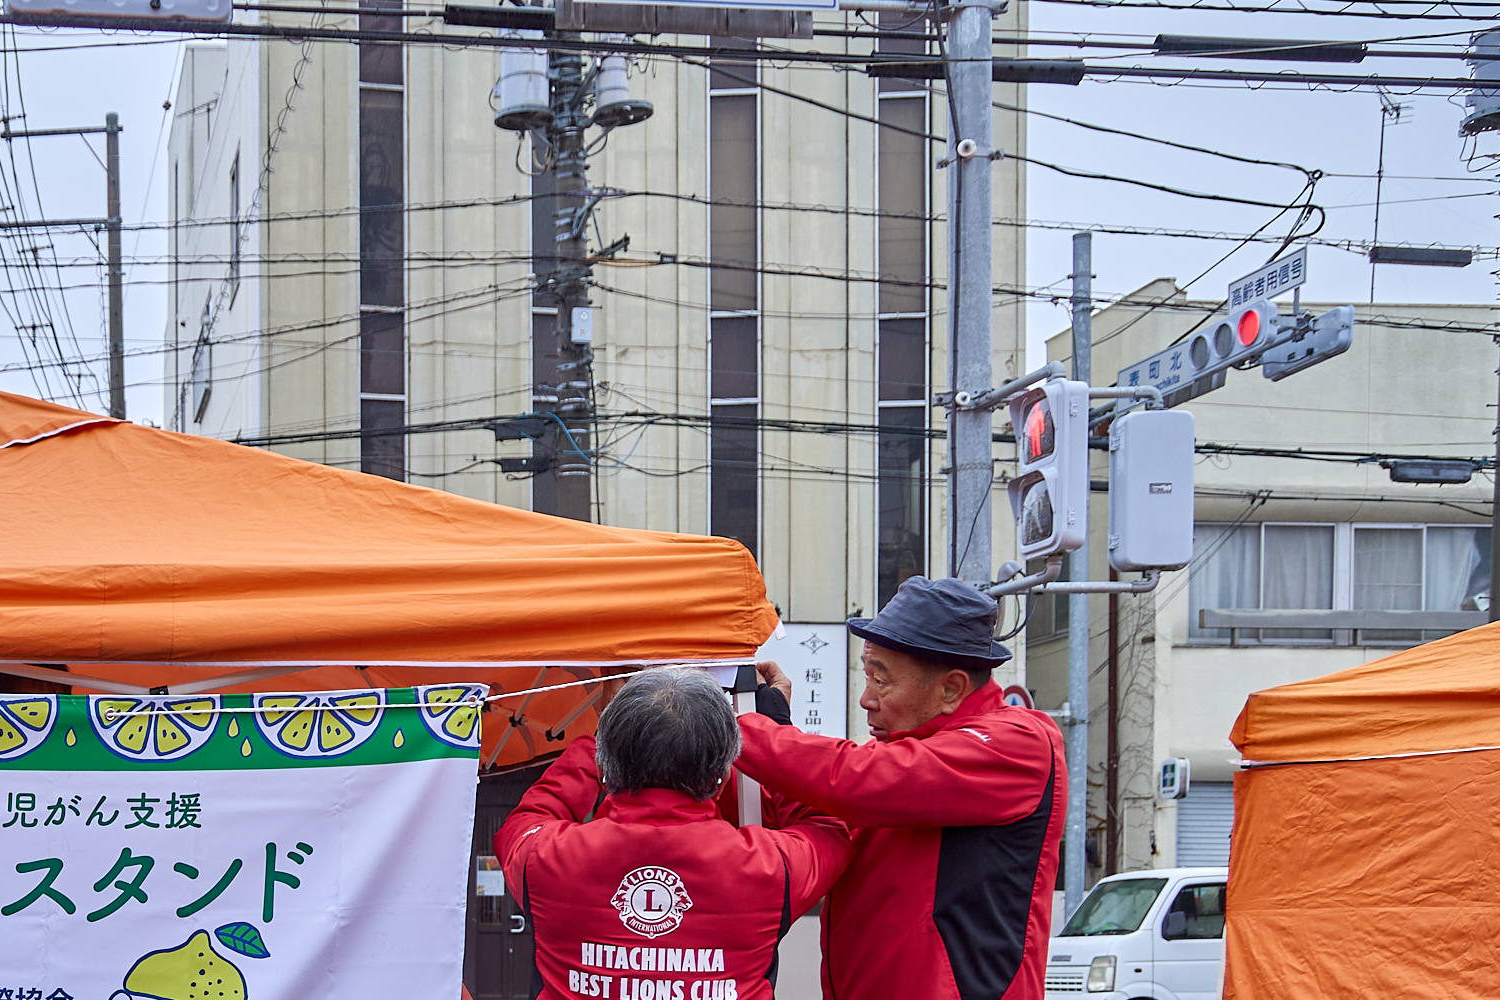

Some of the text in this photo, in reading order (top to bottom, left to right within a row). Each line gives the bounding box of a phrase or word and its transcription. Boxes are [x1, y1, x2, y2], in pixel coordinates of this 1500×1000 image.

[1231, 257, 1303, 310] 高齢者用信号
[628, 868, 677, 886] LIONS
[643, 889, 663, 912] L
[628, 918, 675, 933] INTERNATIONAL
[581, 942, 725, 973] HITACHINAKA
[568, 969, 613, 999] BEST
